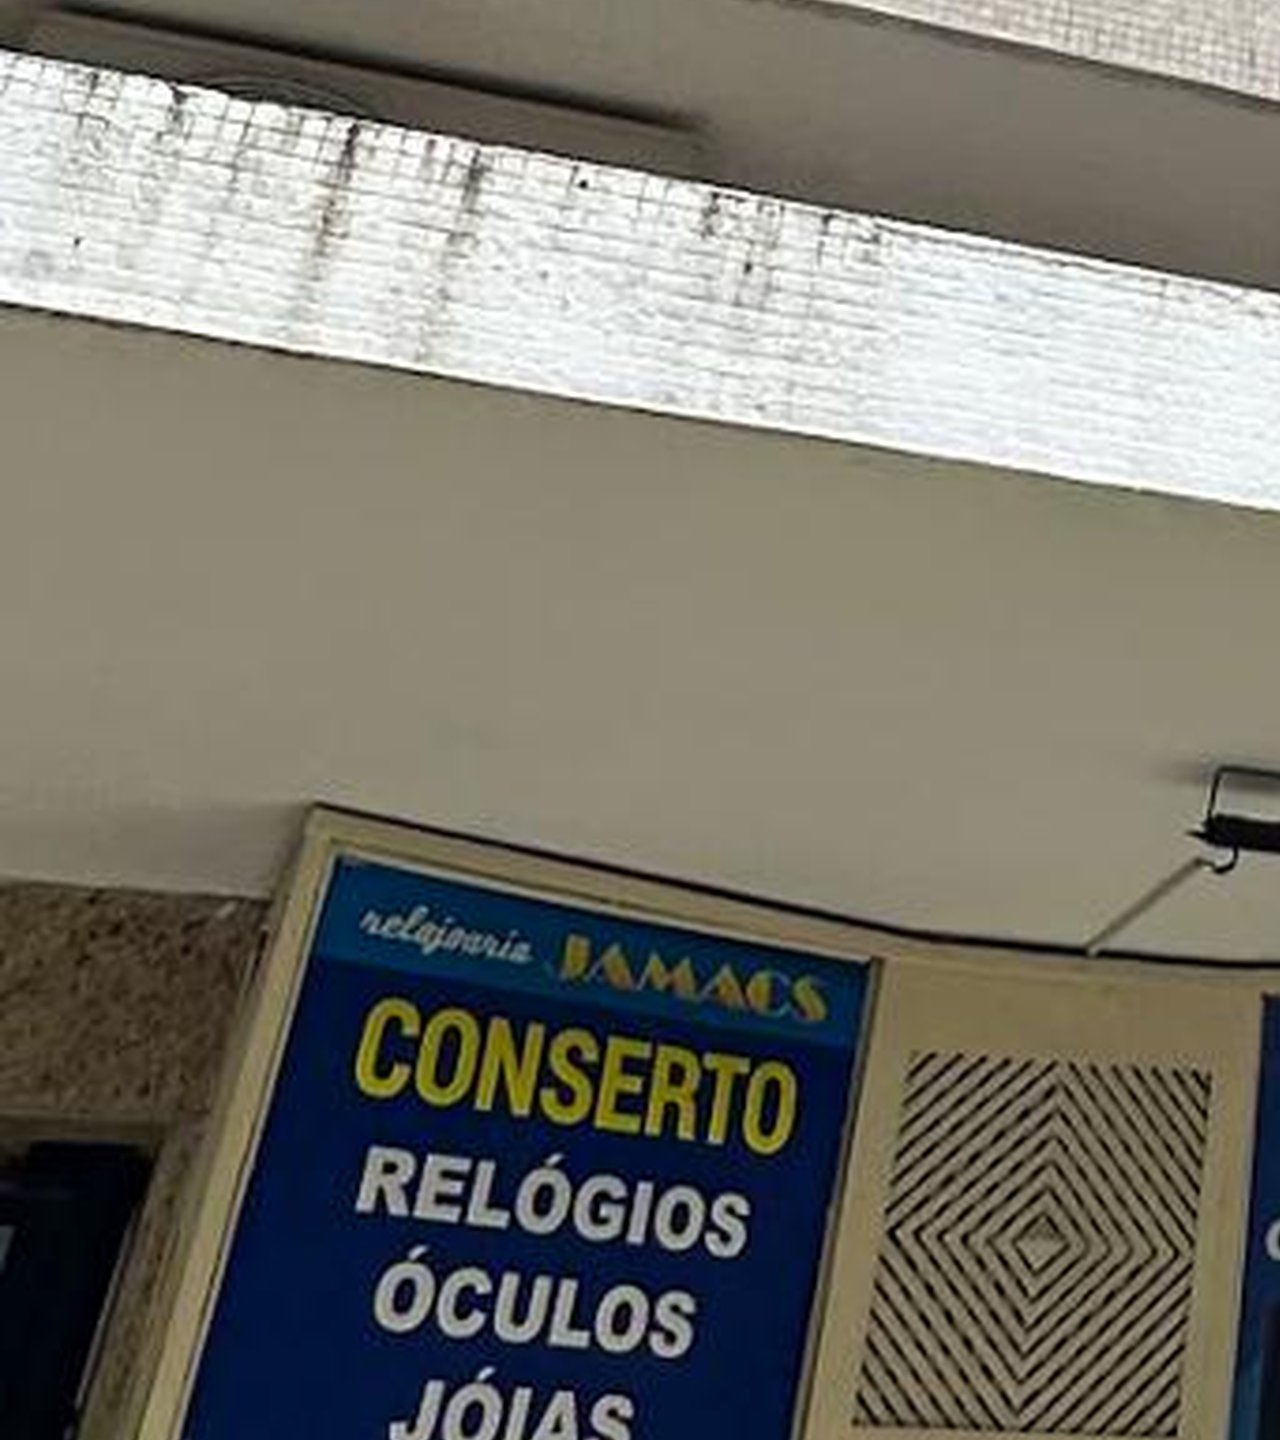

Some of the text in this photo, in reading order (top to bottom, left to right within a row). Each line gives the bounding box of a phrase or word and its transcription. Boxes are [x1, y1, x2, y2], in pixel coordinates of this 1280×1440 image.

[355, 997, 797, 1156] CONSERTO
[355, 1144, 750, 1259] RELÓGIOS
[373, 1245, 697, 1359] ÓCULOS
